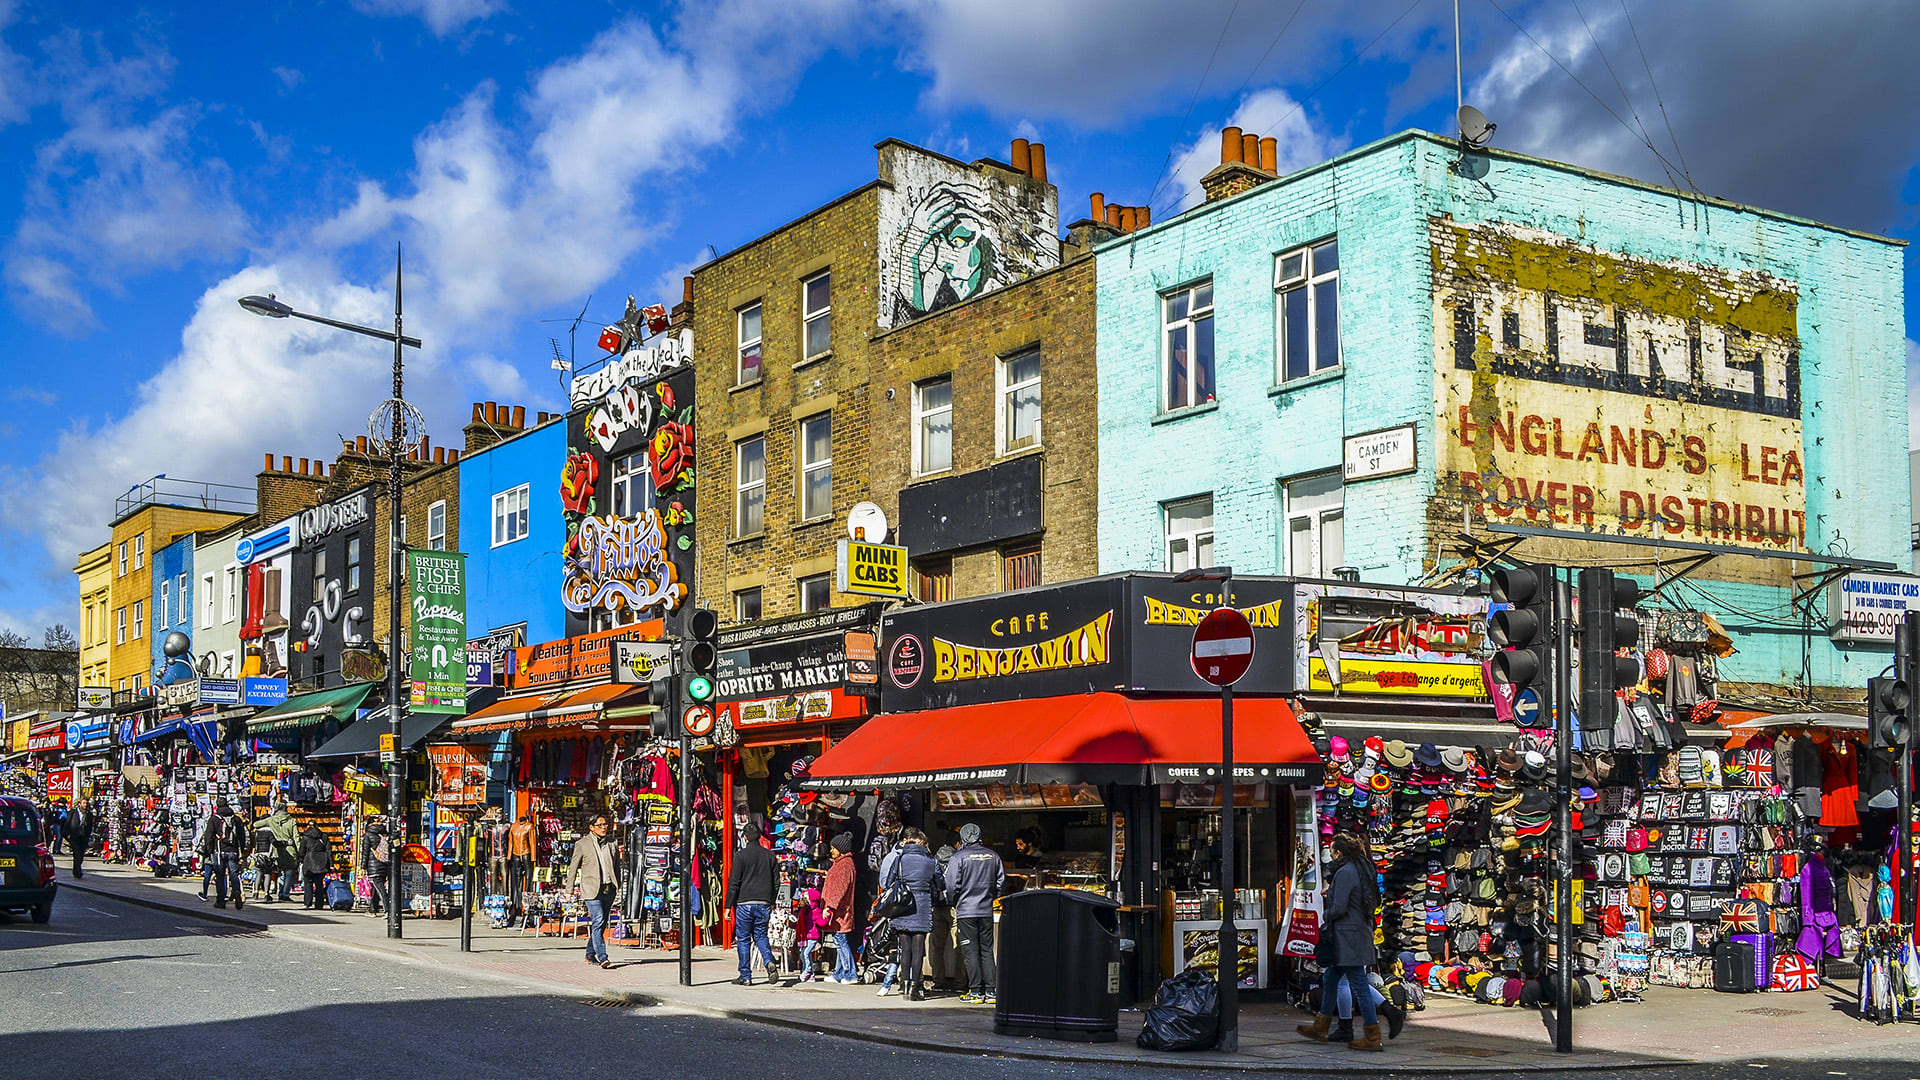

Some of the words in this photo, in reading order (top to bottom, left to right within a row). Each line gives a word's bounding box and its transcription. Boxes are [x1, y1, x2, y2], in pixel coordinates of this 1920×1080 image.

[1358, 440, 1399, 459] CAMDEN
[1459, 404, 1708, 478] ENGLAND'S
[1369, 457, 1381, 470] ST
[415, 556, 459, 570] BRITISH
[855, 545, 898, 566] MINI
[416, 566, 460, 586] FISH
[855, 564, 899, 584] CABS
[416, 583, 425, 593] &
[427, 584, 461, 596] CHIPS
[1842, 578, 1871, 594] CAMDEN
[1872, 581, 1901, 596] MARKET
[1902, 583, 1919, 598] CARS
[419, 625, 459, 635] Restaurant
[721, 634, 735, 645] BAGS
[738, 629, 762, 641] LUGGAGE
[781, 618, 817, 633] SUNGLASSES
[819, 615, 835, 626] BODY
[990, 611, 1049, 637] CAFE
[1843, 611, 1875, 635] 7428
[425, 634, 440, 642] Take
[441, 635, 459, 645] Away
[932, 609, 1113, 683] BENJAMIN
[466, 651, 490, 664] HER
[532, 643, 576, 661] Leather
[467, 664, 482, 677] OP
[620, 655, 670, 671] Martens
[716, 666, 735, 678] eather
[738, 660, 793, 677] Bureau-de-Change
[797, 656, 822, 668] Vintage
[428, 671, 433, 680] 1
[433, 671, 449, 681] Min
[528, 667, 572, 684] Souvenirs
[573, 665, 581, 676] &
[780, 663, 849, 690] MARKET
[1442, 673, 1480, 690] d'argent
[247, 691, 286, 699] EXCHANGE
[433, 753, 452, 765] HEAP
[851, 778, 869, 786] FRESH
[868, 777, 882, 786] FAST
[882, 776, 898, 785] FOOD
[906, 775, 917, 784] THE
[934, 771, 969, 782] BAGUETTES
[977, 769, 1007, 779] BURGERS
[1168, 767, 1200, 777] COFFEE
[1221, 767, 1254, 777] EPES
[1275, 767, 1305, 777] PANINI
[48, 774, 72, 791] Sale
[48, 794, 60, 802] UP
[1667, 878, 1689, 886] LAWYER
